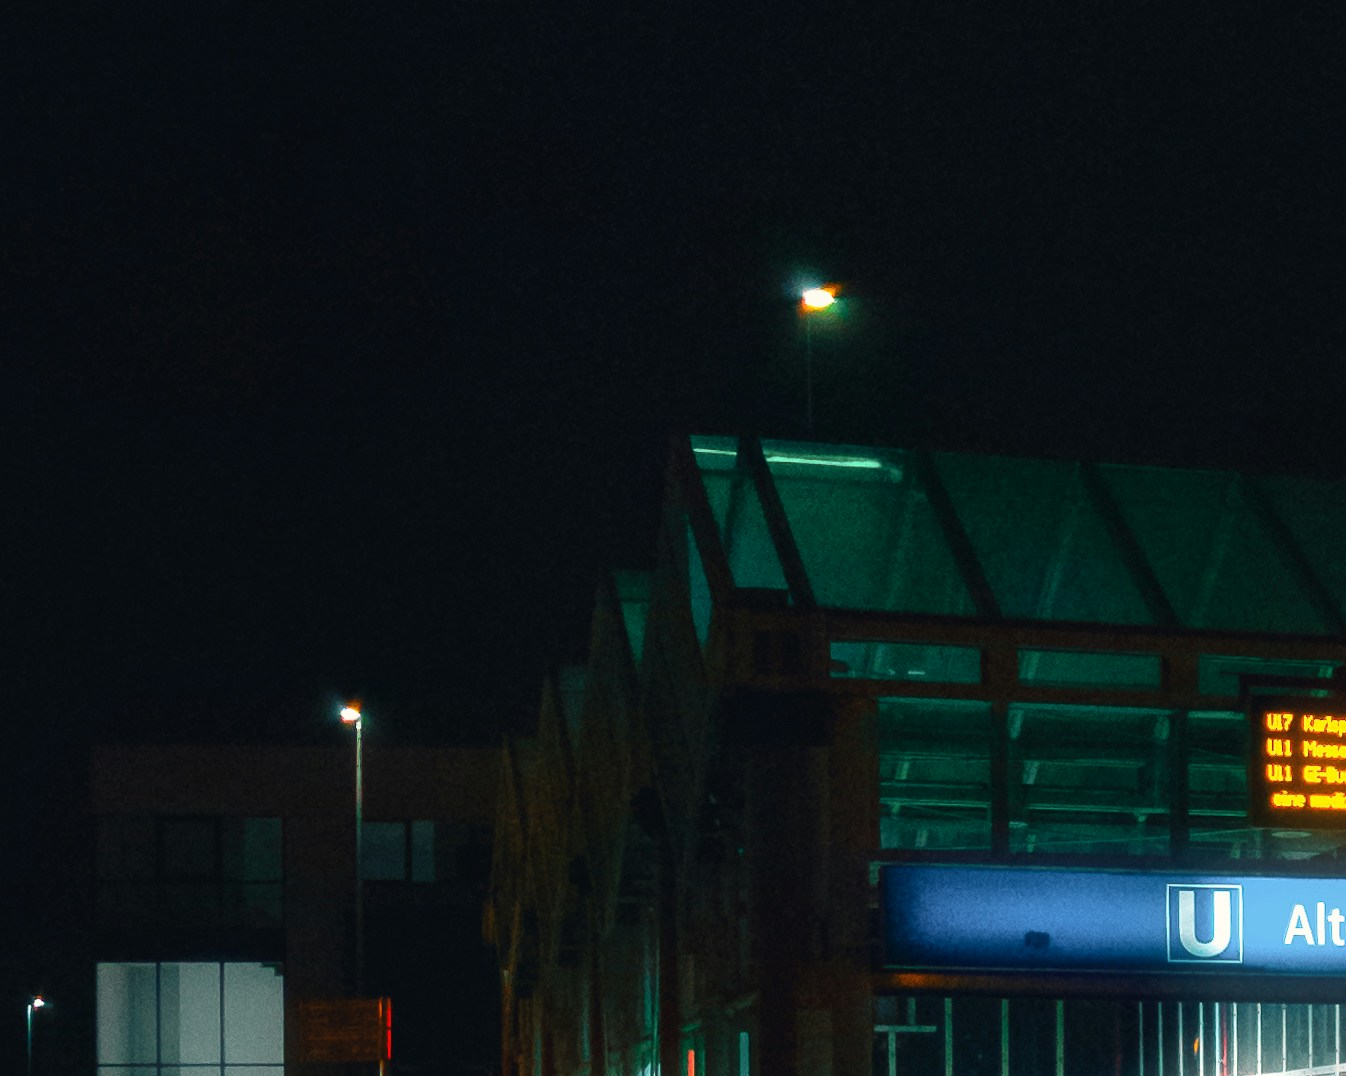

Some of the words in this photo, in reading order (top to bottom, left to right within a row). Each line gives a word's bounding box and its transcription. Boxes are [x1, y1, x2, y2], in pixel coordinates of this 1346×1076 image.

[1266, 713, 1293, 732] U17
[1266, 738, 1292, 757] U11
[1266, 764, 1293, 782] U11
[1178, 890, 1231, 958] U
